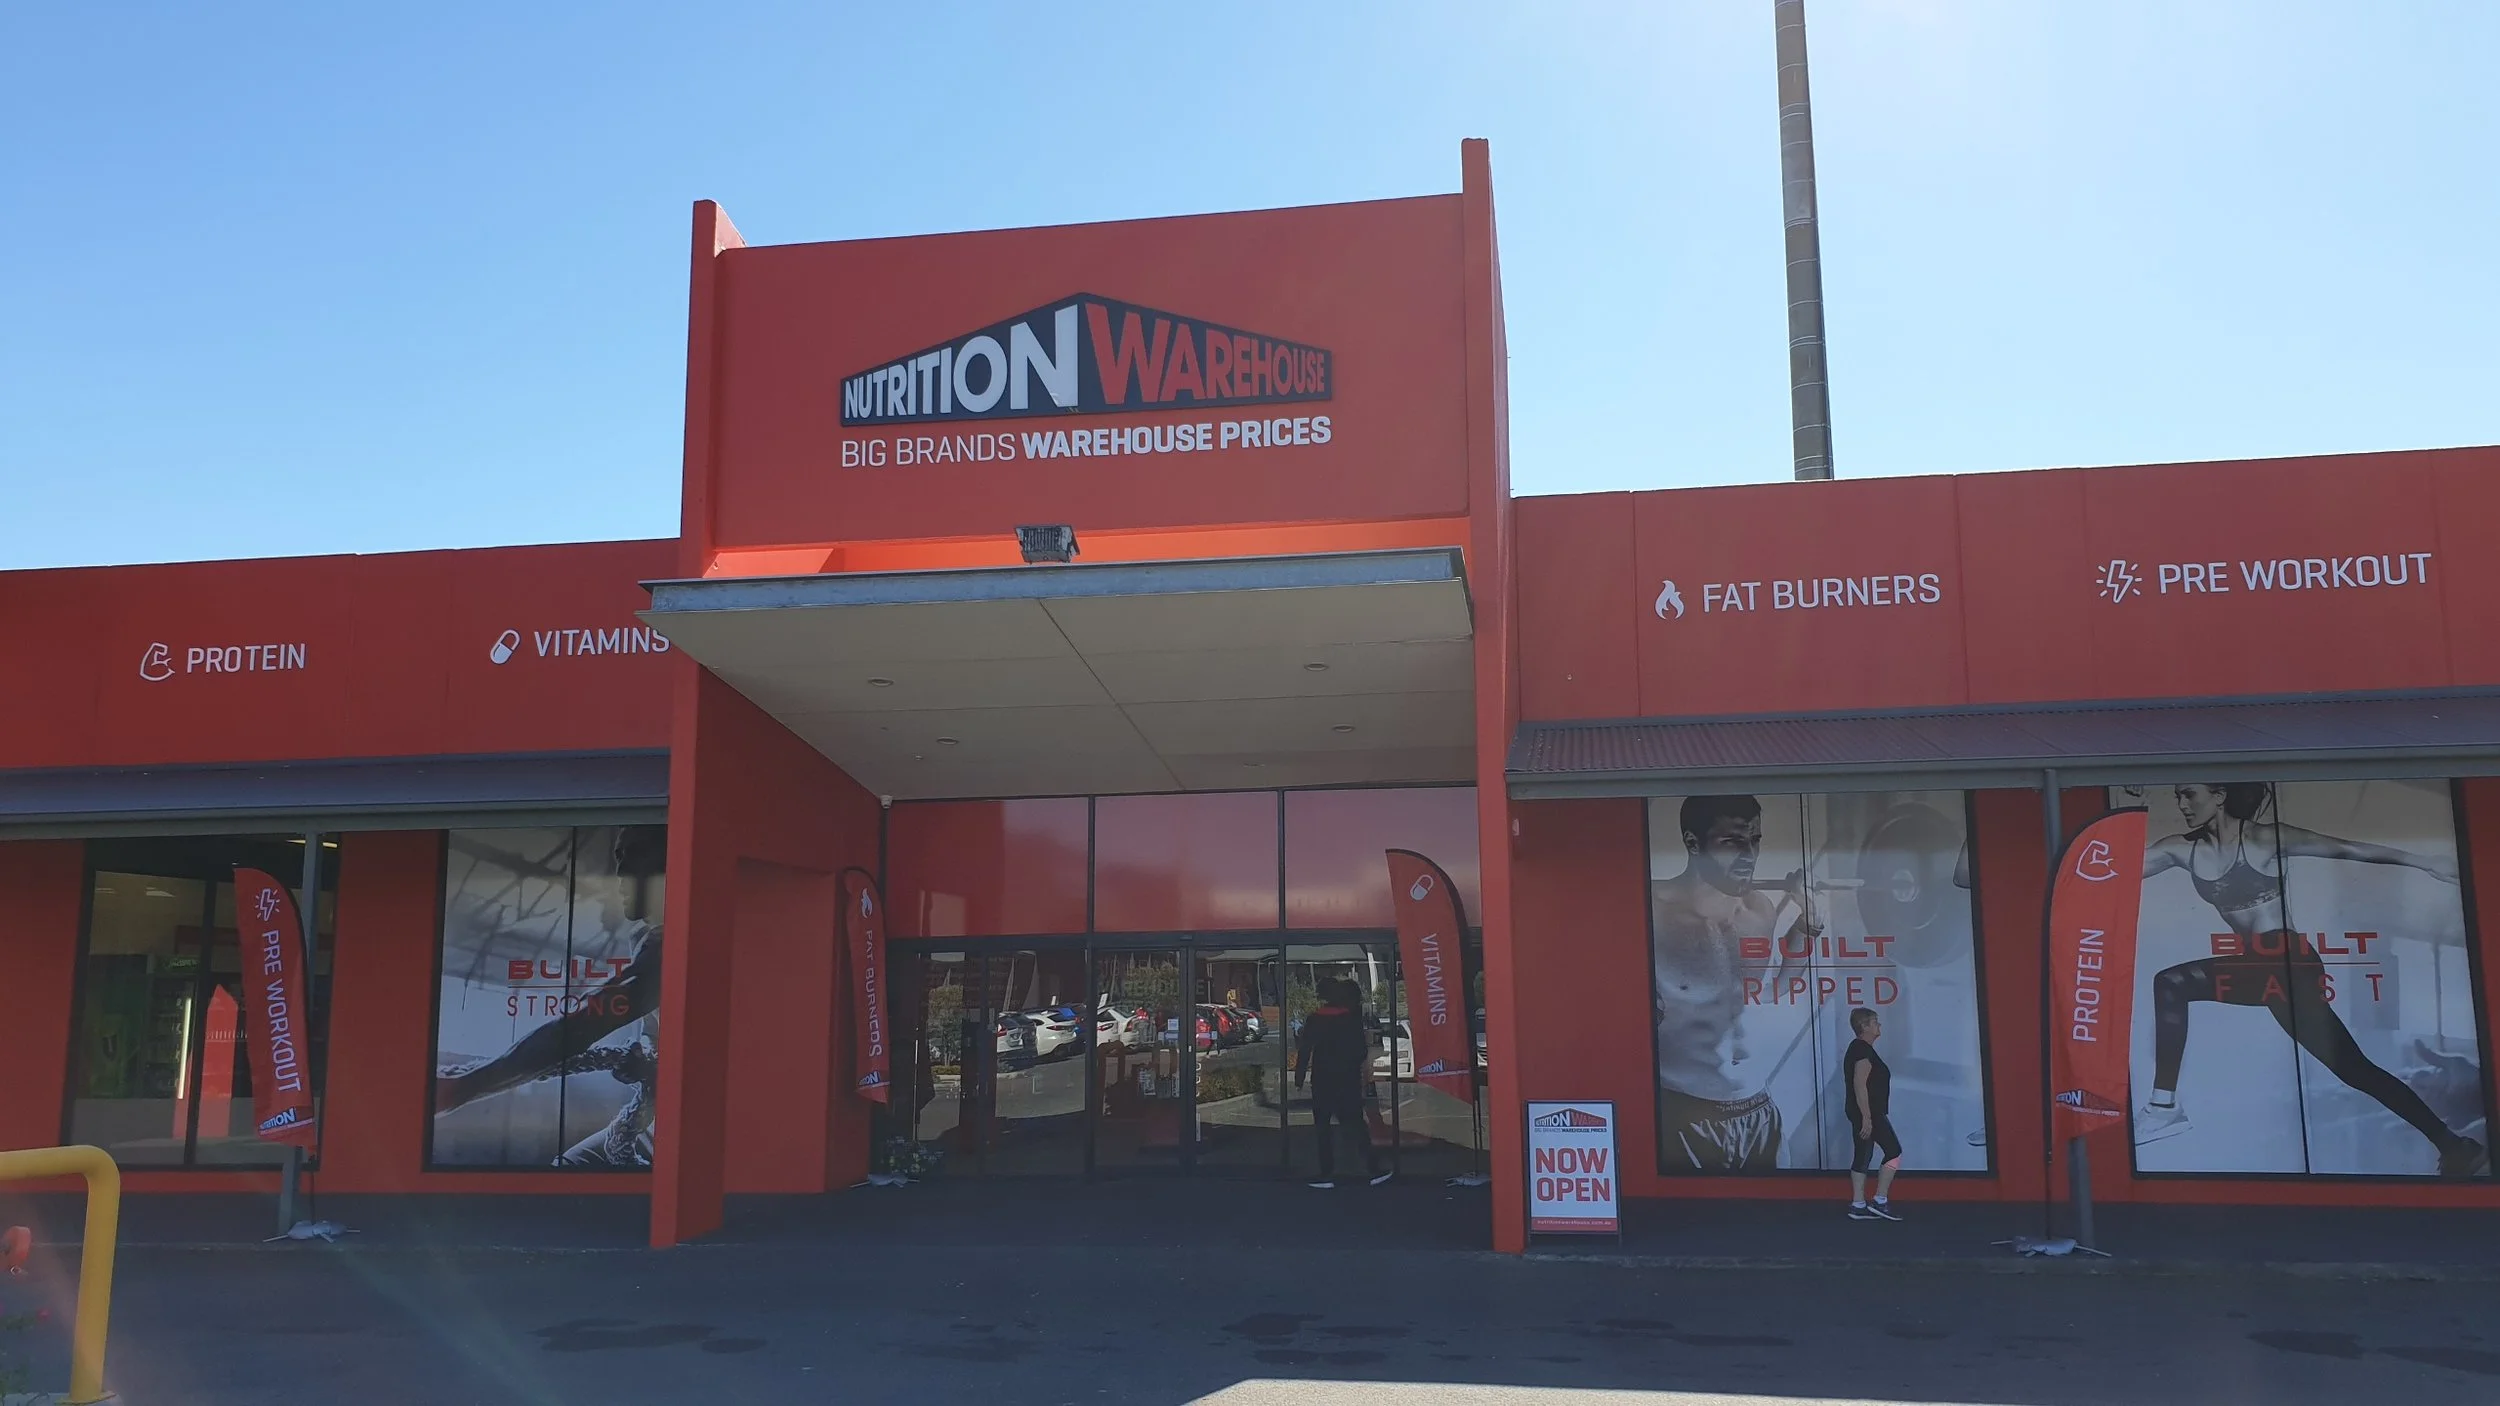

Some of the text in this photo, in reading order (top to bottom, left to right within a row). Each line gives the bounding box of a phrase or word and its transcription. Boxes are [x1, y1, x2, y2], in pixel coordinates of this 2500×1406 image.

[844, 302, 1325, 419] NUTRITION WAREHOUSE
[841, 415, 1332, 468] BIG BRANDS WAREHOUSE PRICES
[2158, 552, 2432, 594] PRE WORKOUT
[1703, 573, 1941, 613] FAT BURNERS
[534, 626, 670, 657] VITAMINS
[187, 643, 306, 673] PROTEIN
[262, 929, 282, 976] PRE
[1740, 936, 1896, 959] BUILT
[2210, 931, 2379, 956] BUILT
[508, 957, 632, 980] BUILT
[1421, 932, 1447, 1027] VITAMINS
[1744, 976, 1899, 1006] RIPPED
[2073, 929, 2105, 1043] PROTEIN
[2215, 972, 2384, 1004] FAST
[507, 994, 631, 1017] STRONG
[266, 979, 302, 1092] WORKOUT
[1535, 1147, 1608, 1174] NOW
[1536, 1177, 1611, 1202] OPEN
